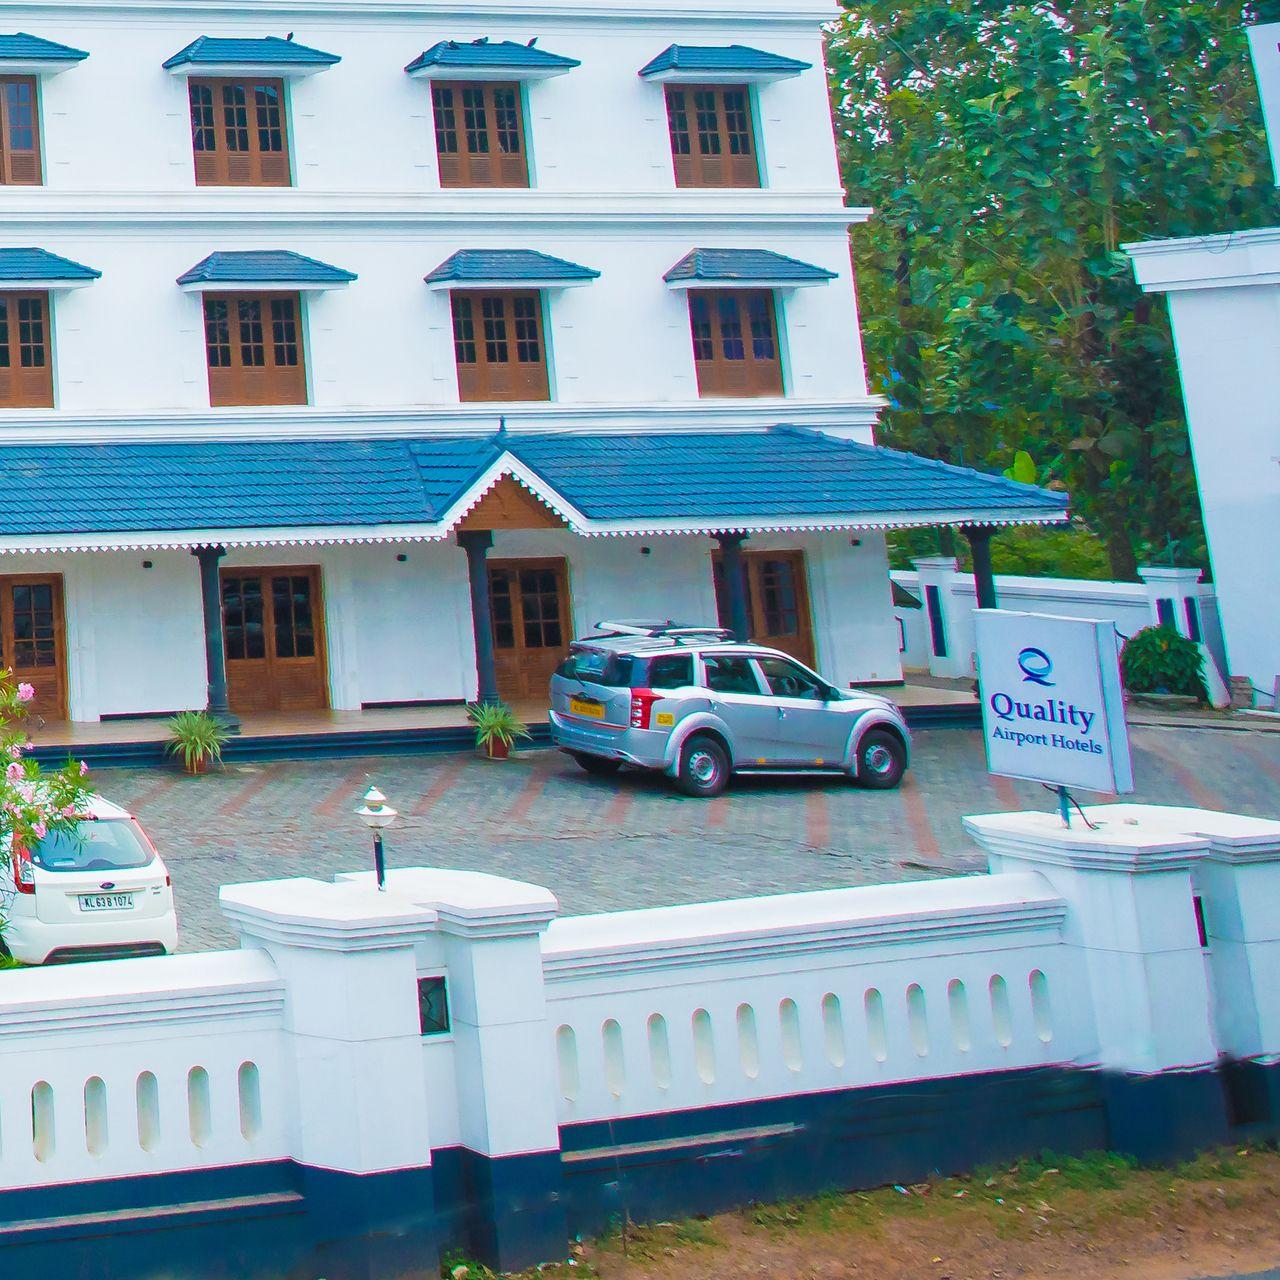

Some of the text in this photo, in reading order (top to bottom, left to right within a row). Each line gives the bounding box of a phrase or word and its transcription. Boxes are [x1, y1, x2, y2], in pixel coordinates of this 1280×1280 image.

[990, 693, 1096, 734] Quality
[992, 726, 1103, 755] Airport Hotels
[84, 897, 95, 908] KL
